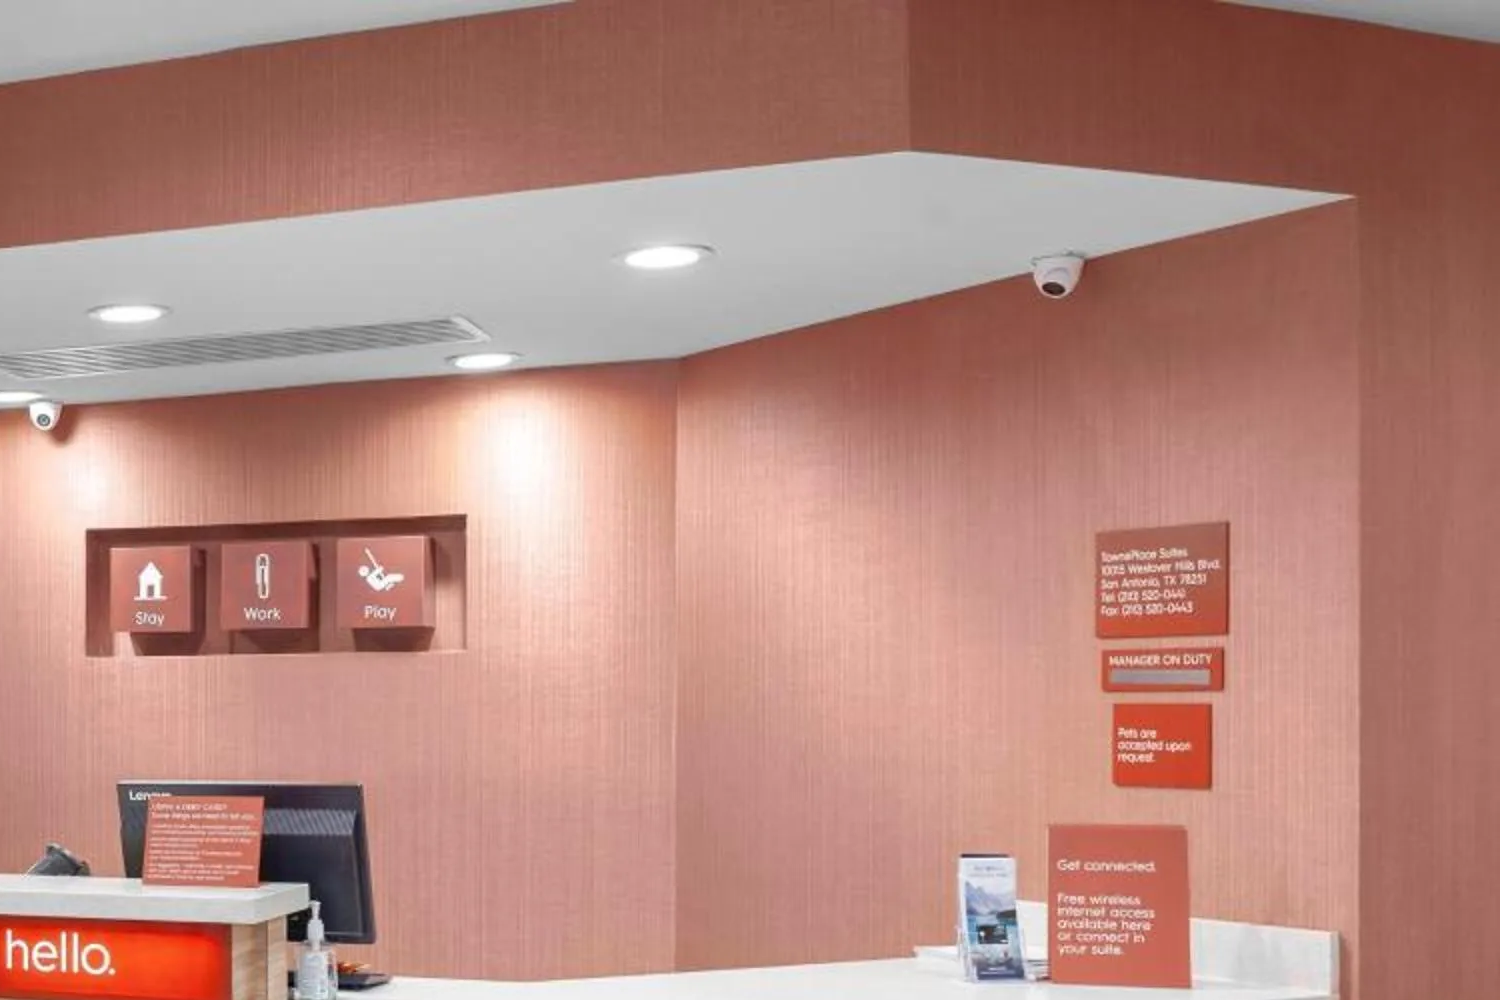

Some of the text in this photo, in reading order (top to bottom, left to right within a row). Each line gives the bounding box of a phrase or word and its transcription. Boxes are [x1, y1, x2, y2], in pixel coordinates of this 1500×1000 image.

[1159, 547, 1188, 559] Suites
[1127, 562, 1172, 575] Westover
[1175, 560, 1195, 572] Hills
[1197, 559, 1220, 571] Blvd.
[1101, 578, 1118, 589] San
[1163, 575, 1179, 586] TX
[135, 611, 165, 626] Stay
[243, 606, 282, 621] Work
[363, 604, 398, 620] Play
[1108, 653, 1212, 666] MANAGER ON DUTY
[1117, 727, 1157, 739] Pets are
[1117, 740, 1192, 753] accepted upon
[1056, 859, 1156, 873] Get connected.
[1057, 892, 1141, 905] Free wireless
[1110, 908, 1156, 919] access
[1057, 918, 1153, 931] available here
[1057, 931, 1146, 944] or connect in
[5, 928, 116, 976] hello.
[1057, 944, 1087, 957] your
